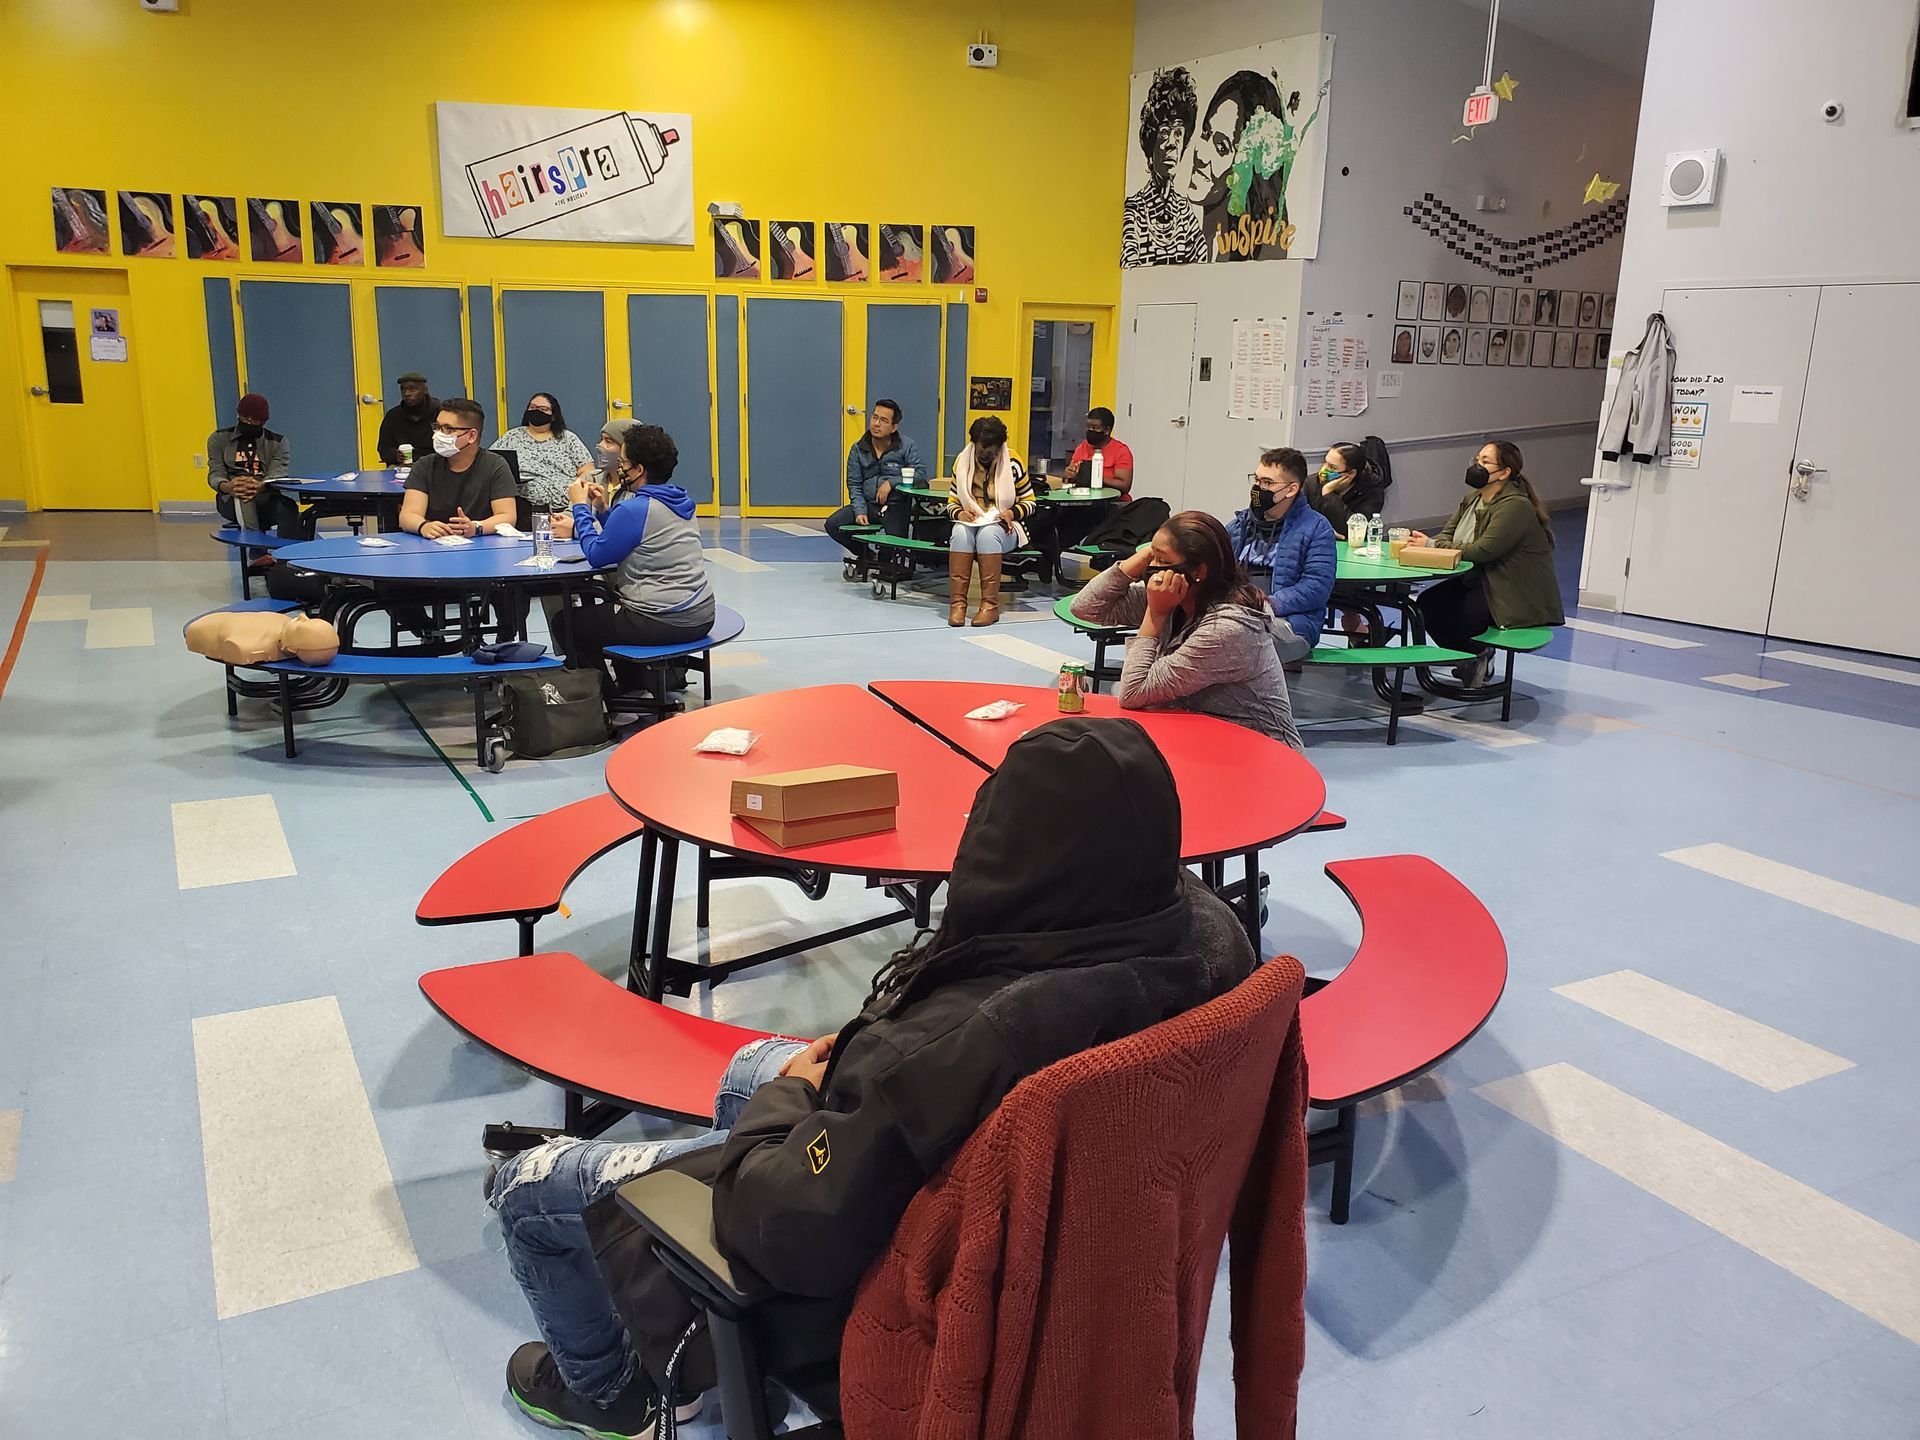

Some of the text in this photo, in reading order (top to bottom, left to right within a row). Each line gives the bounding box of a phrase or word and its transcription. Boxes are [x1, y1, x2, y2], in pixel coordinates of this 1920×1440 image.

[1467, 96, 1491, 123] EXIT
[1704, 375, 1712, 383] I
[1713, 376, 1725, 384] DO
[1676, 388, 1705, 397] TODAY?
[1674, 405, 1699, 415] WOW
[1671, 440, 1693, 448] GOOD
[1673, 448, 1689, 456] JOB
[665, 1338, 685, 1379] HAYNES
